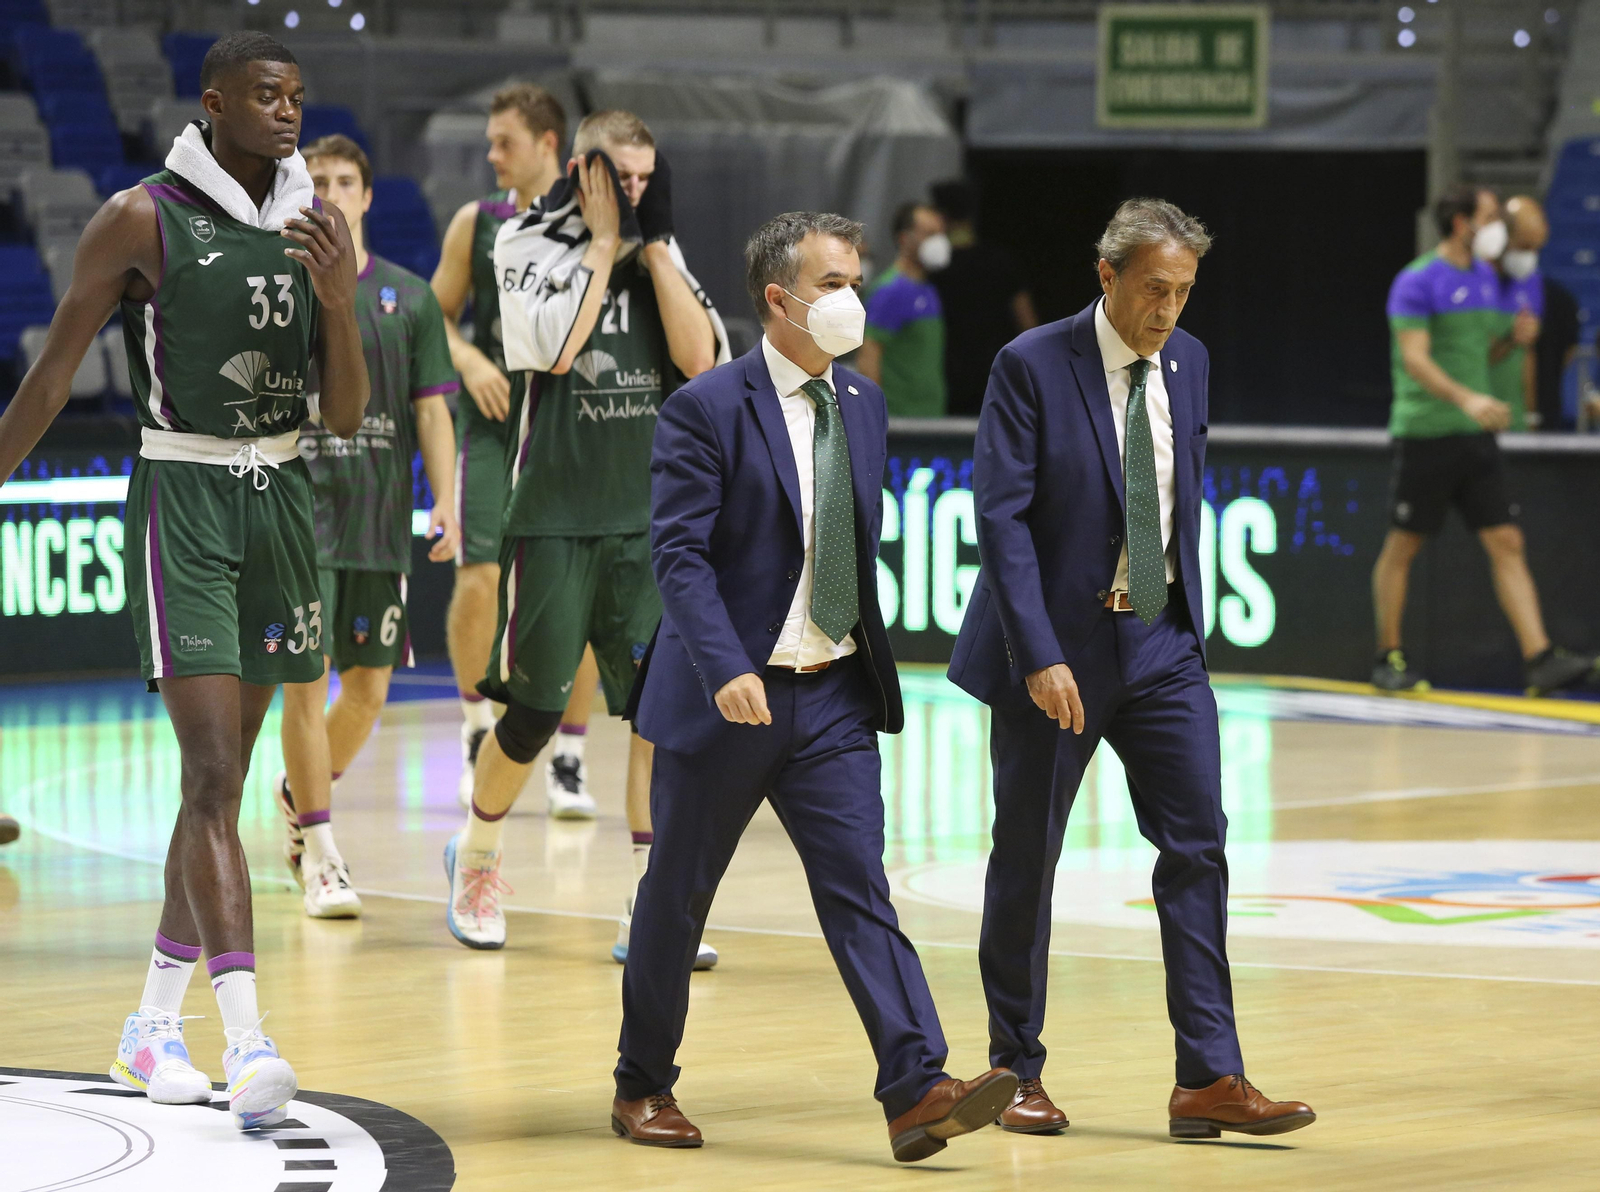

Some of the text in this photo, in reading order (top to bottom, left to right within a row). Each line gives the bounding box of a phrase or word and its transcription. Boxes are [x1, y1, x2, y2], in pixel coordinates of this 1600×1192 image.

[246, 274, 295, 330] 33
[601, 288, 630, 335] 21
[577, 394, 659, 422] Andalucía
[180, 634, 214, 649] Málaga
[287, 600, 322, 655] 33
[380, 604, 402, 647] 6
